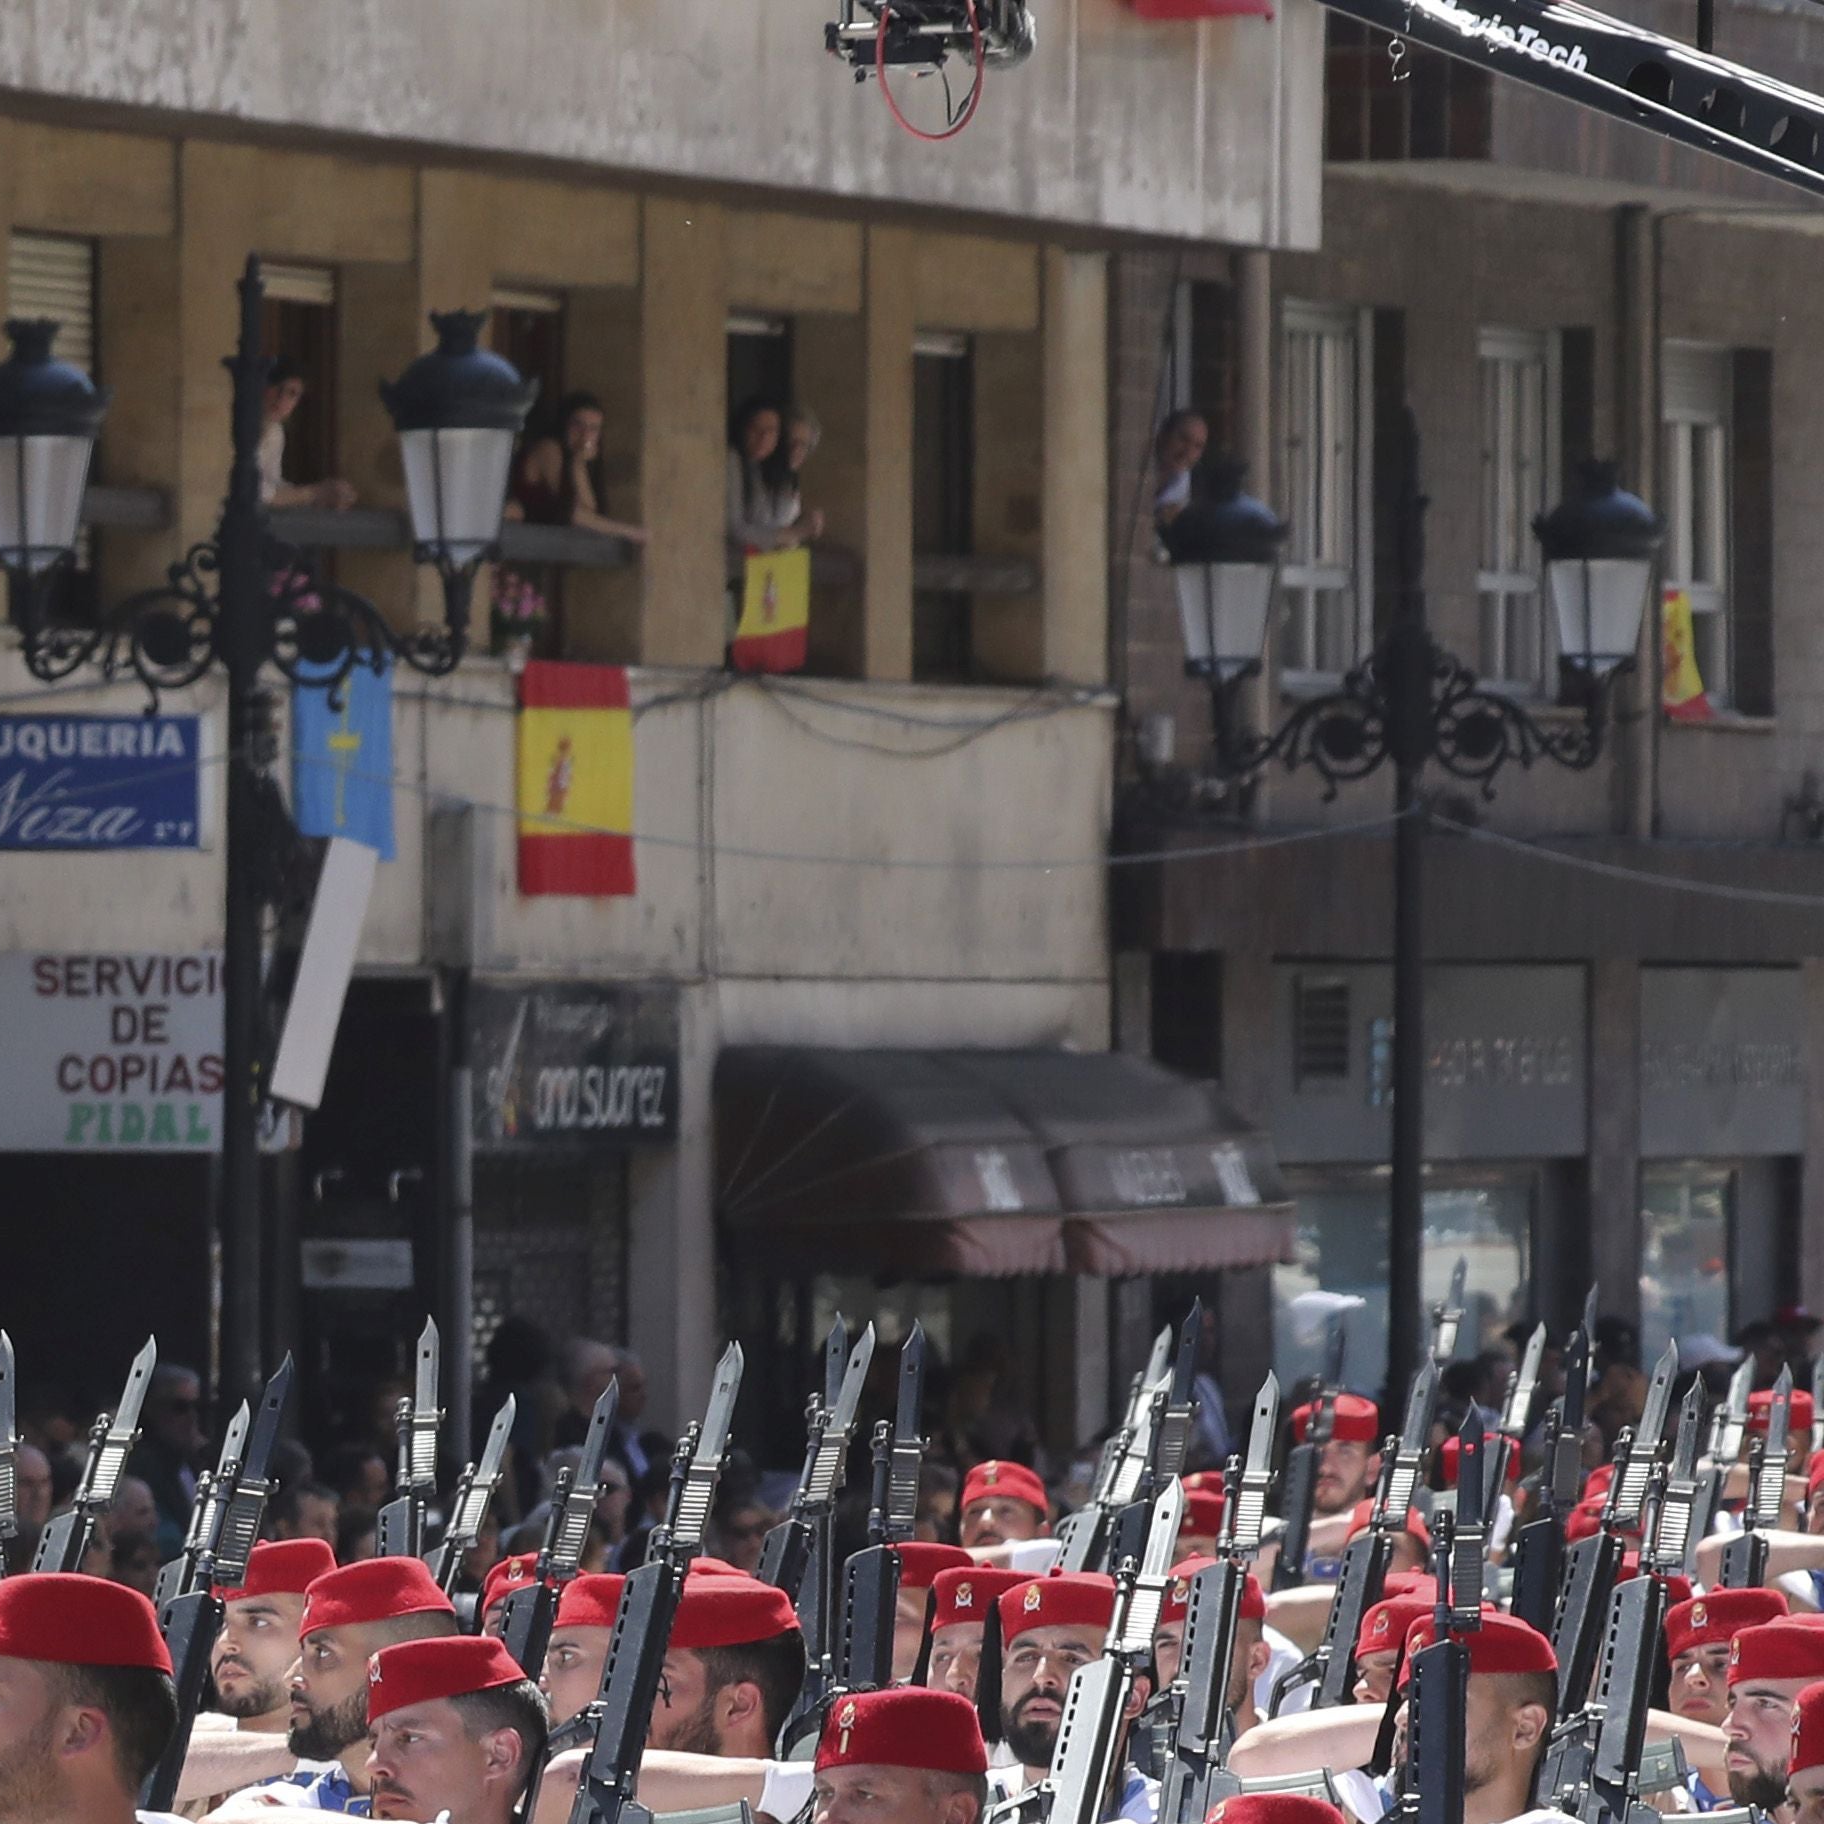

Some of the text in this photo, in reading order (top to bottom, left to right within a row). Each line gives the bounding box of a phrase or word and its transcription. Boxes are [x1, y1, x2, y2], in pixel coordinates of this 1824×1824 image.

[33, 956, 226, 998] SERVICI
[110, 1003, 170, 1045] DE
[56, 1053, 226, 1095] COPIAS
[64, 1102, 212, 1145] PIDAL
